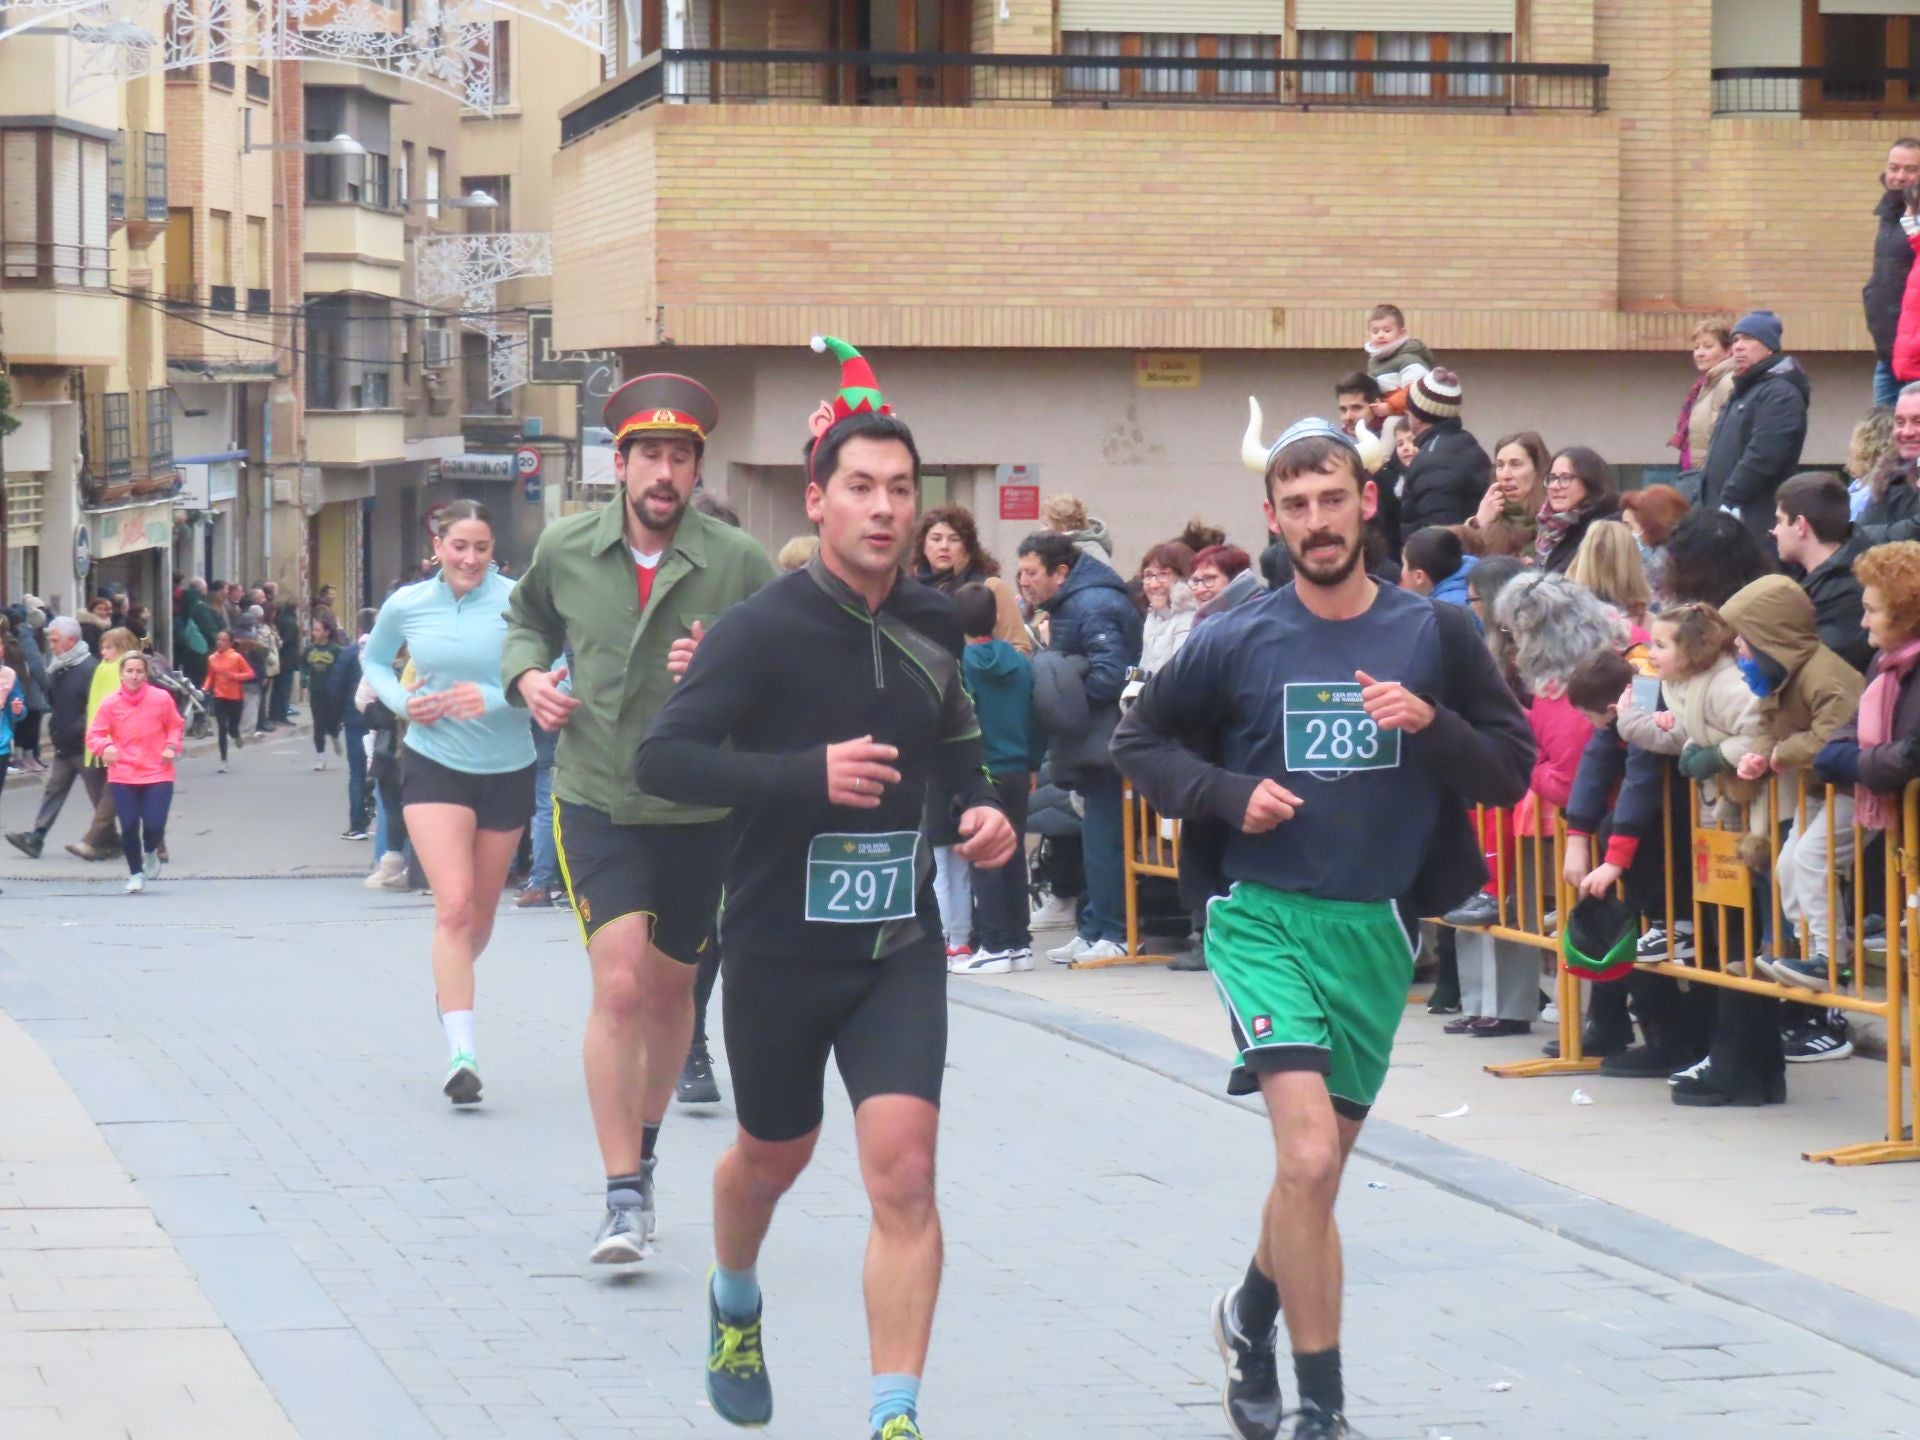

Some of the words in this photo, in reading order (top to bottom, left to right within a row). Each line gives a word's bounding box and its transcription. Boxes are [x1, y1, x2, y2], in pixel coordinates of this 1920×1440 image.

[519, 457, 534, 467] 20
[1305, 718, 1379, 760] 283
[827, 867, 898, 911] 297
